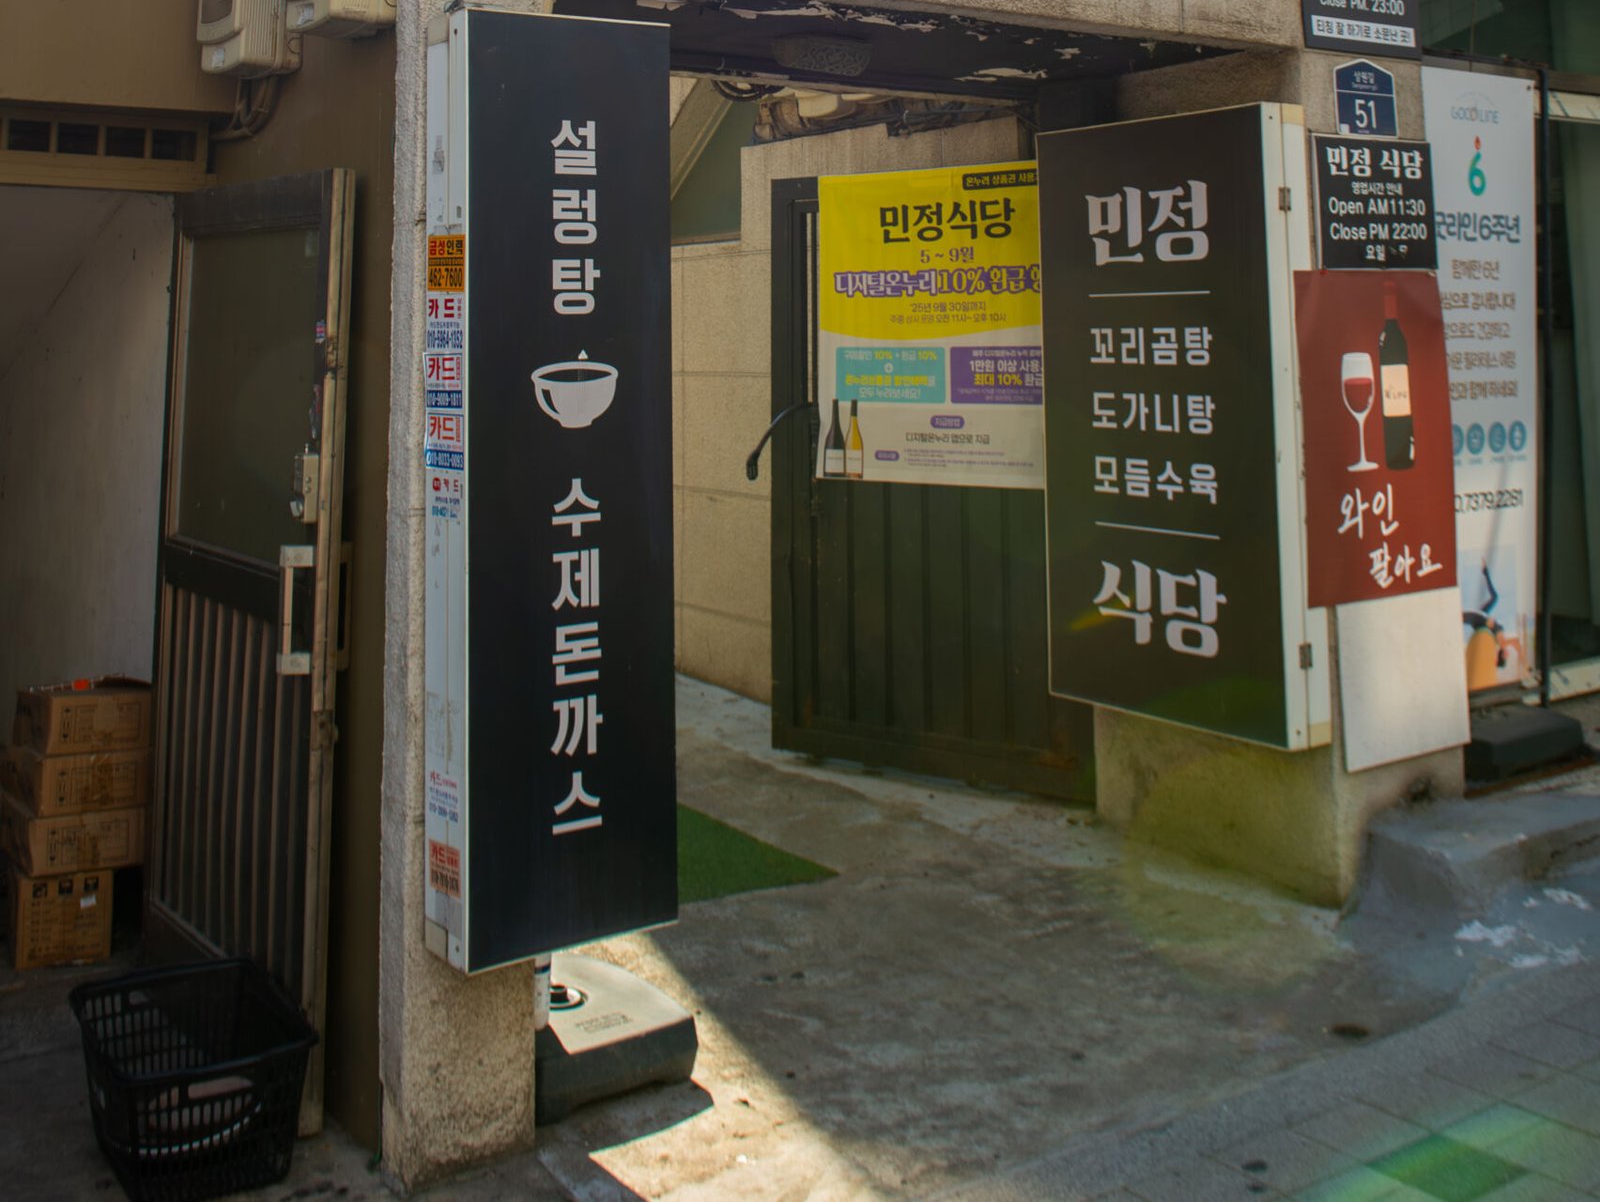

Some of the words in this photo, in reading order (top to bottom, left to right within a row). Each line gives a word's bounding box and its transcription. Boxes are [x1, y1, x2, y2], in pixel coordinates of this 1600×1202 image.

[1355, 99, 1377, 129] 51
[1019, 171, 1039, 183] 사용
[1325, 146, 1372, 177] 민정
[1379, 149, 1424, 179] 식당
[551, 119, 601, 315] 설렁탕
[879, 197, 1016, 244] 민정식당
[1085, 180, 1210, 266] 민정
[1328, 197, 1364, 217] Open
[1329, 222, 1367, 240] Close
[1369, 223, 1390, 240] PM
[1392, 223, 1428, 240] 22:00
[938, 267, 986, 295] 10%
[1089, 325, 1213, 367] 꼬리곰탕
[428, 356, 455, 381] 카드
[974, 374, 995, 387] 최대
[997, 374, 1023, 386] 10%
[997, 359, 1017, 373] 이상
[1019, 359, 1043, 373] 사용
[430, 415, 455, 440] 카드
[1092, 391, 1216, 435] 도가니탕
[1094, 454, 1218, 504] 모듬수육
[1338, 483, 1400, 540] 와인
[1368, 541, 1443, 589] 팔아요
[1092, 559, 1228, 658] 식당
[551, 478, 603, 836] 수제돈까스
